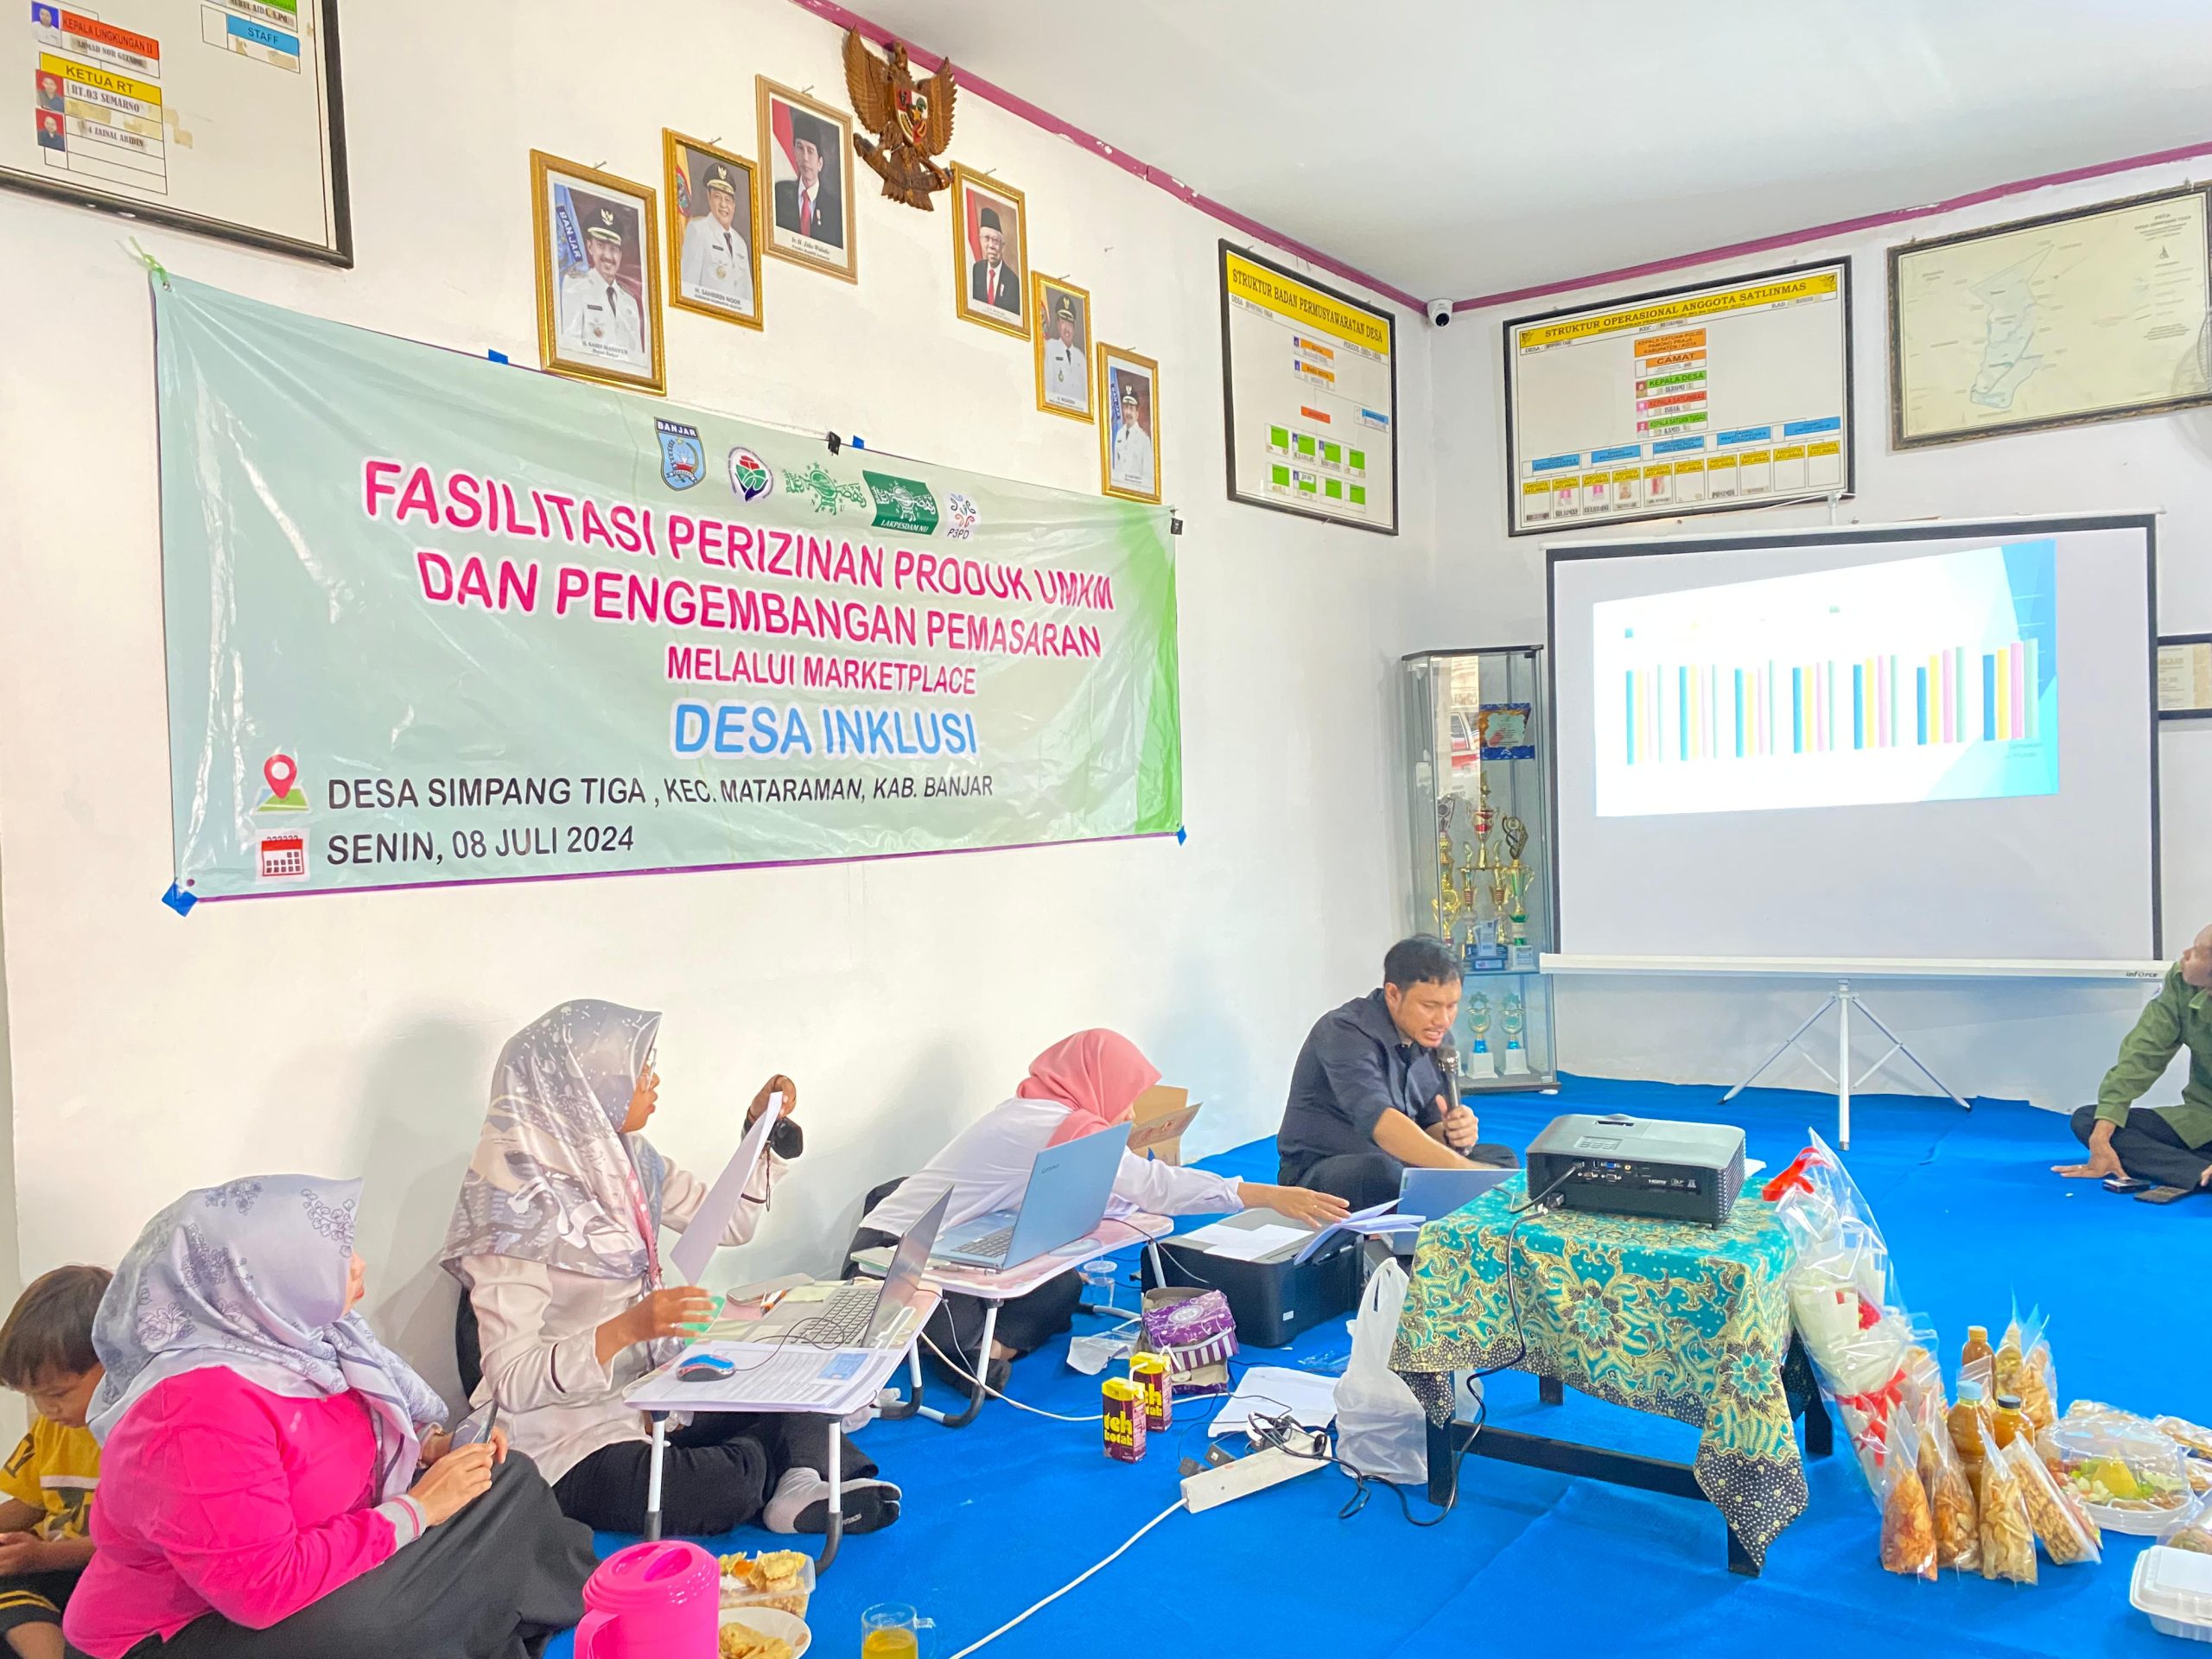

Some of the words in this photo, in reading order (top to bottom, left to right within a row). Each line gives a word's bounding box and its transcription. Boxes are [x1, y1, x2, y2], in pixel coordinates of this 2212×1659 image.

[62, 17, 93, 35] KEPALA
[95, 27, 143, 51] LINGKUNGAN
[145, 42, 153, 54] II
[248, 28, 278, 44] STAFF
[66, 65, 113, 88] KETUA
[118, 80, 134, 94] RT
[72, 84, 98, 101] RT.03
[101, 93, 140, 112] SUMARNO
[95, 127, 118, 140] ZAINAL
[559, 211, 582, 257] BANJAR
[1233, 269, 1272, 297] STRUKTUR
[1274, 286, 1298, 308] BADAN
[1299, 298, 1365, 334] PERMUSYAWARATAN
[1366, 326, 1382, 342] DESA
[1545, 320, 1599, 338] STRUKTUR
[1603, 303, 1679, 327] OPERASIONAL
[1682, 296, 1736, 312] ANGGOTA
[1739, 282, 1807, 302] SATLINMAS
[1656, 353, 1695, 365] CAMAT
[1649, 374, 1680, 387] KEPALA
[1681, 372, 1704, 381] DESA
[657, 421, 696, 437] BANJAR
[365, 460, 656, 556] FASILITASI
[669, 515, 883, 588] PERIZINAN
[894, 550, 1033, 602] PRODUK
[1034, 569, 1115, 610] UMKM
[880, 519, 919, 531] LAKPESDAM
[918, 524, 930, 532] NU
[947, 528, 970, 540] P3PD
[416, 551, 537, 613] DAN
[556, 568, 917, 646] PENGEMBANGAN
[927, 610, 1102, 658] PEMASARAN
[667, 646, 795, 686] MELALUI
[804, 656, 976, 695] MARKETPLACE
[675, 703, 812, 754] DESA
[823, 709, 976, 754] INKLUSI
[328, 778, 419, 810] DESA
[428, 777, 571, 807] SIMPANG
[581, 777, 646, 804] TIGA
[664, 778, 716, 804] KEC.
[720, 777, 865, 804] MATARAMAN,
[873, 777, 917, 799] KAB.
[923, 775, 993, 798] BANJAR
[327, 830, 443, 866] SENIN,
[452, 830, 486, 859] 08
[495, 827, 557, 856] JULI
[567, 825, 634, 852] 2024
[1103, 1410, 1133, 1435] teh
[1104, 1429, 1133, 1446] kotak
